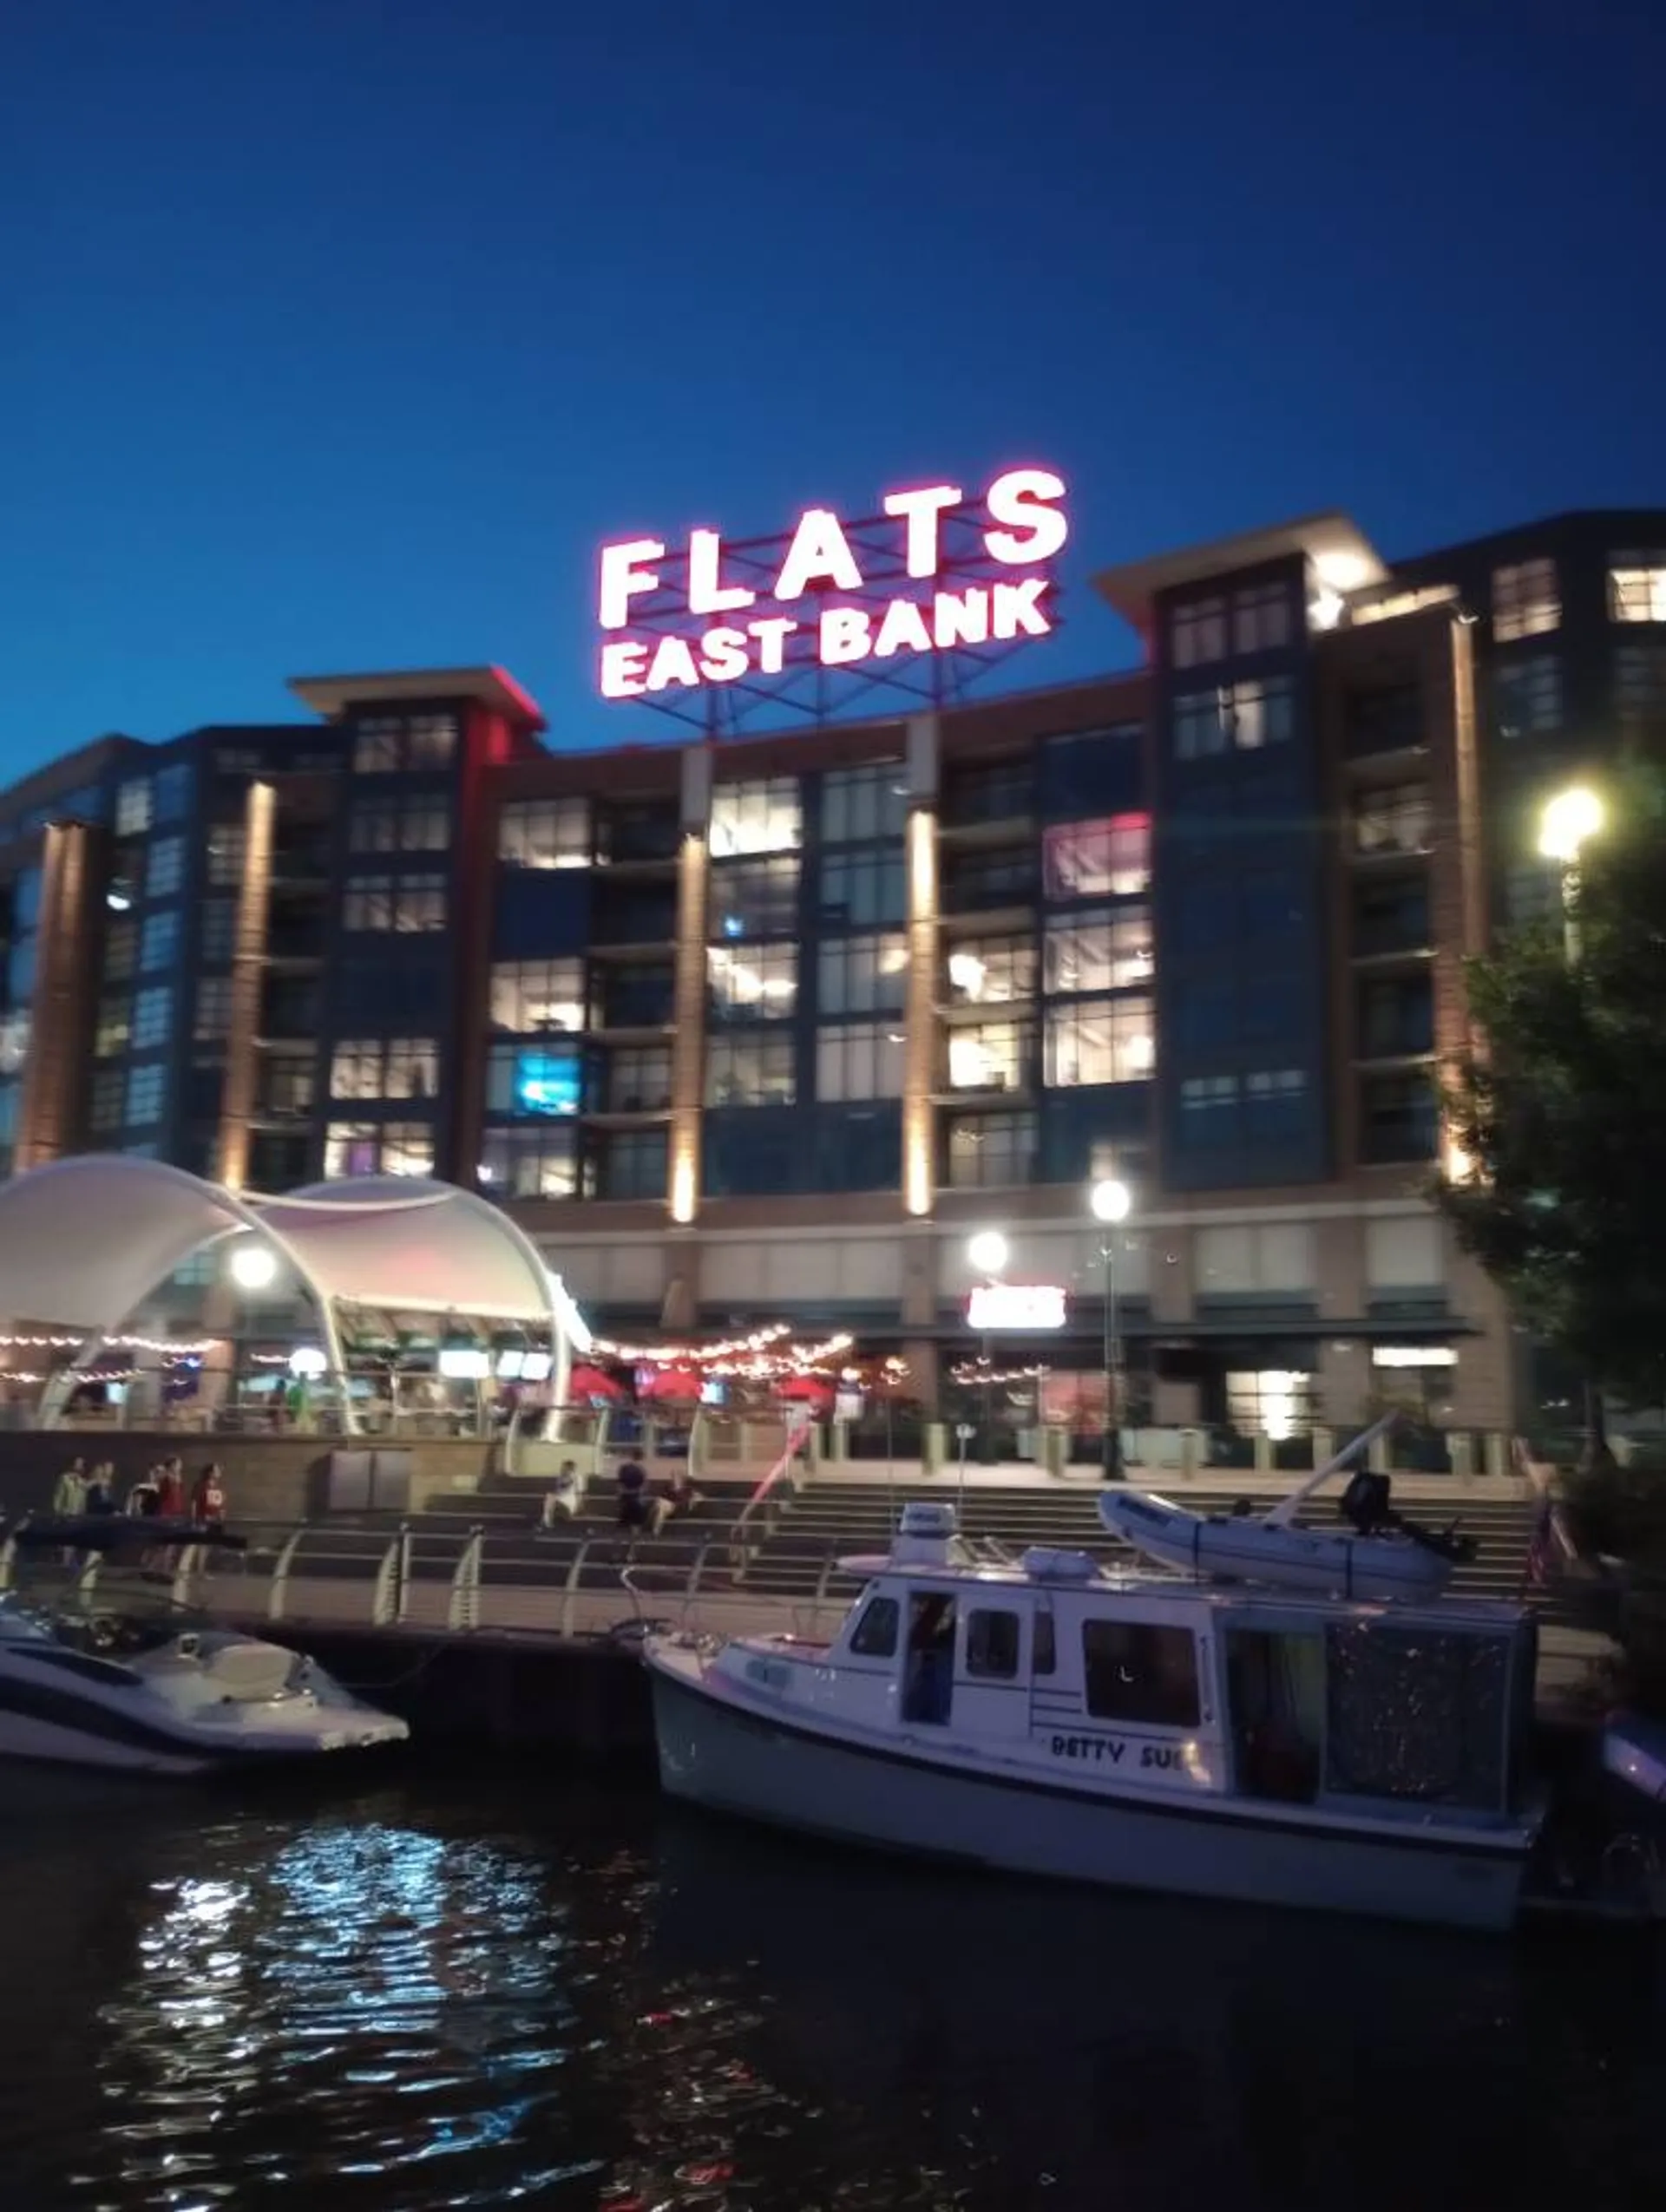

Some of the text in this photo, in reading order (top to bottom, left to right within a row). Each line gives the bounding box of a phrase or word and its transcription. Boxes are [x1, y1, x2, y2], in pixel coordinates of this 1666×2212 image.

[599, 469, 1068, 630] FLATS
[600, 579, 1051, 697] EAST BANK
[1052, 1736, 1125, 1763] BETTY
